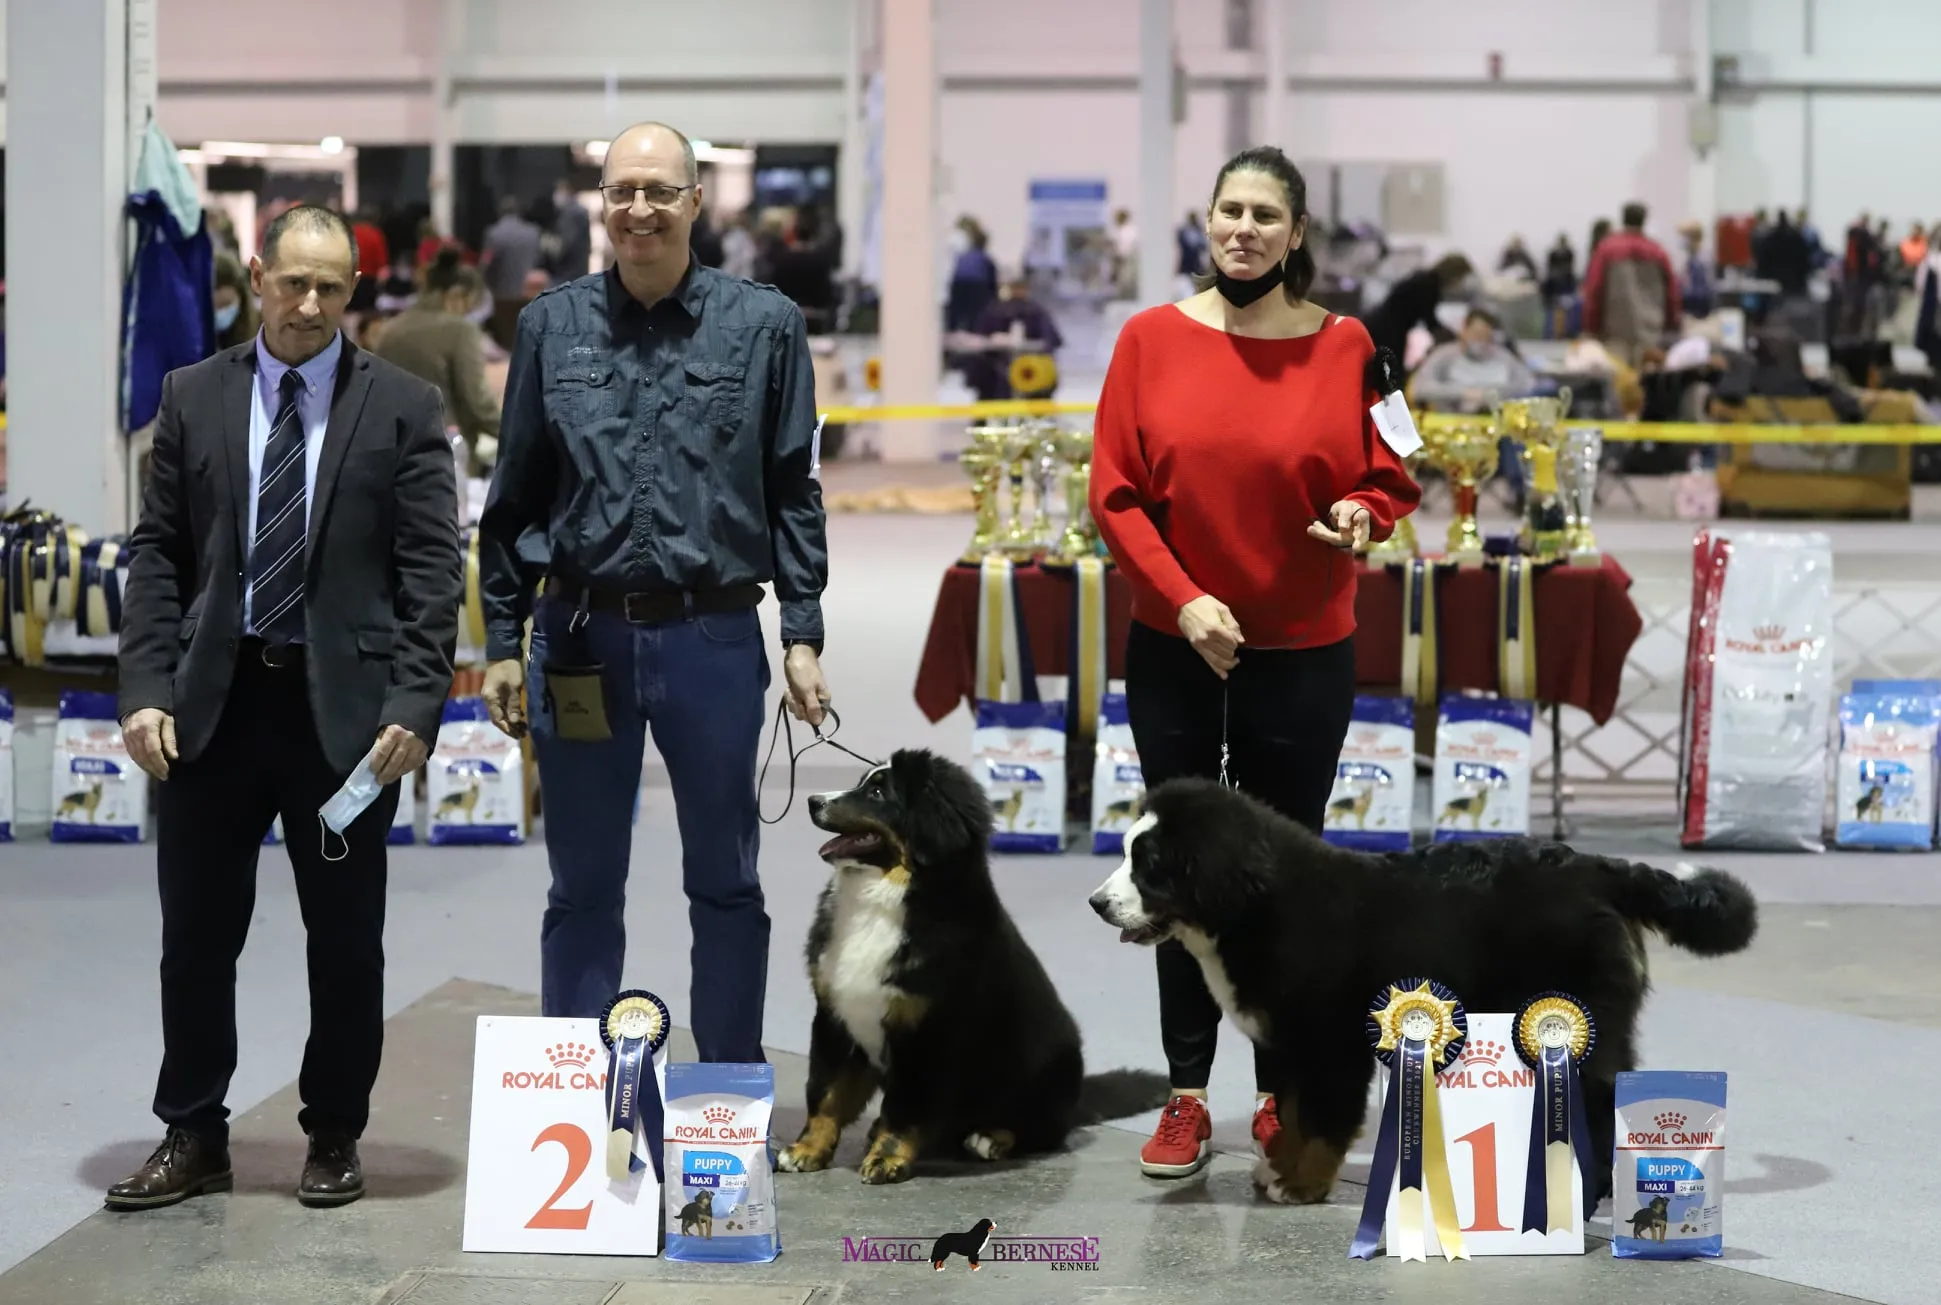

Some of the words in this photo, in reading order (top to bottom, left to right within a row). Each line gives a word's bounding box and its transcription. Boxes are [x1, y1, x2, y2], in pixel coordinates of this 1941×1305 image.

[502, 1071, 565, 1090] ROYAL
[620, 1083, 633, 1119] MINOR
[1554, 1096, 1563, 1132] MINOR
[675, 1125, 716, 1139] ROYAL
[718, 1127, 757, 1140] CANIN
[1627, 1132, 1668, 1145] ROYAL
[1671, 1132, 1713, 1145] CANIN
[694, 1158, 733, 1171] PUPPY
[1648, 1164, 1686, 1176] PUPPY
[523, 1122, 594, 1230] 2
[689, 1175, 713, 1185] MAXI
[1453, 1121, 1515, 1232] 1
[1644, 1183, 1668, 1191] MAXI
